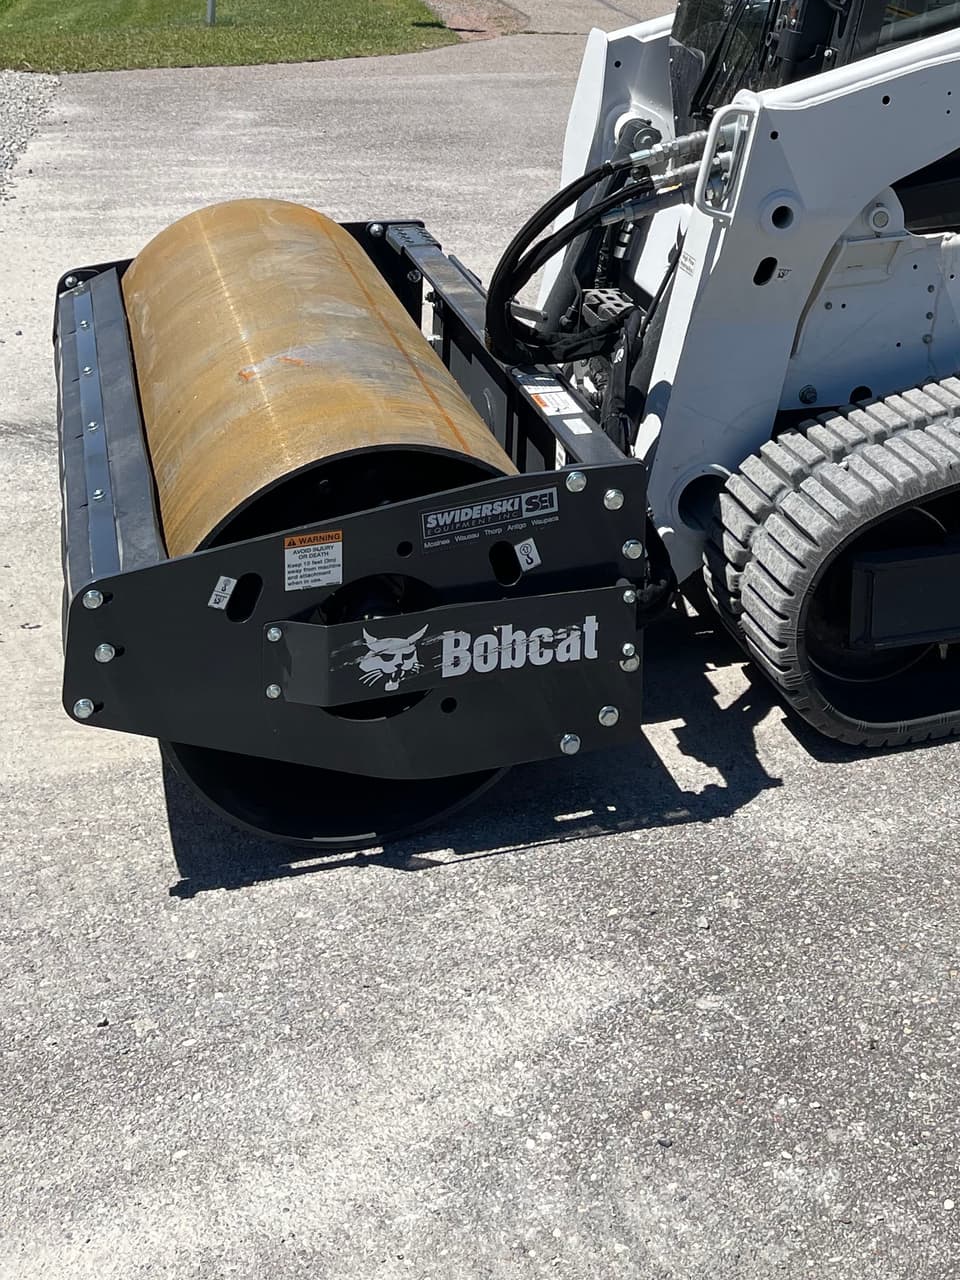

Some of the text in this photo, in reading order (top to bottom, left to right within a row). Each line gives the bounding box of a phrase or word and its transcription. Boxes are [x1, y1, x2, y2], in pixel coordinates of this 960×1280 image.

[426, 491, 555, 528] SWIDERSKI SEI
[427, 517, 492, 536] EQUIPMENT
[484, 527, 503, 537] Thorp
[299, 532, 340, 545] WARNING
[293, 547, 312, 555] AVOID
[441, 615, 599, 678] Bobcat
